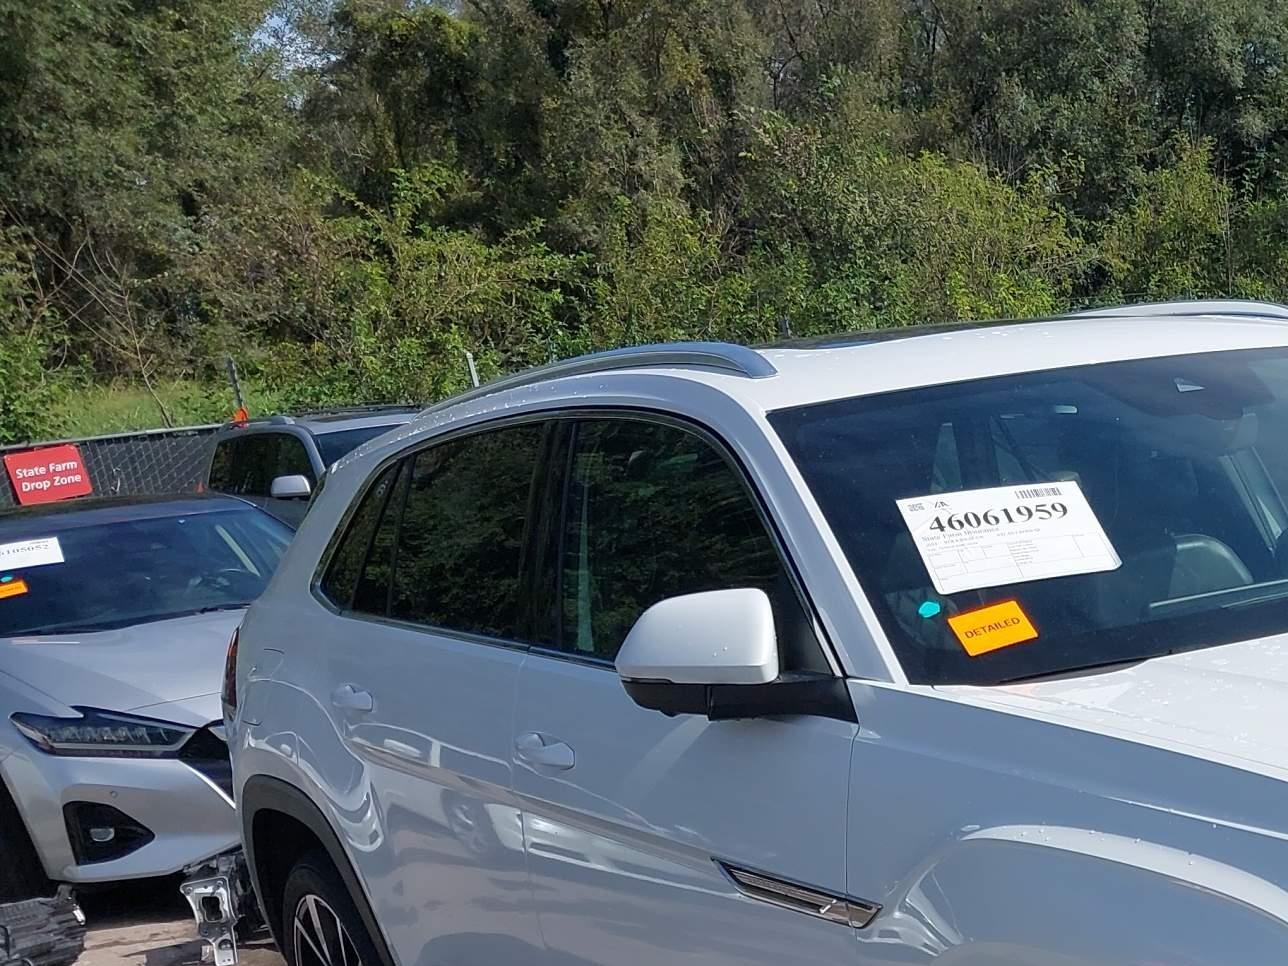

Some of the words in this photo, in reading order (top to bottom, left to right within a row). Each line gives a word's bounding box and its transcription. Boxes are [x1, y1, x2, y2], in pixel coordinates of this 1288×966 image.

[15, 466, 47, 479] State
[48, 461, 78, 473] Farm
[21, 480, 51, 492] Drop
[53, 474, 82, 486] Zone
[929, 502, 1068, 532] 46061959
[964, 617, 1021, 639] DETAILED
